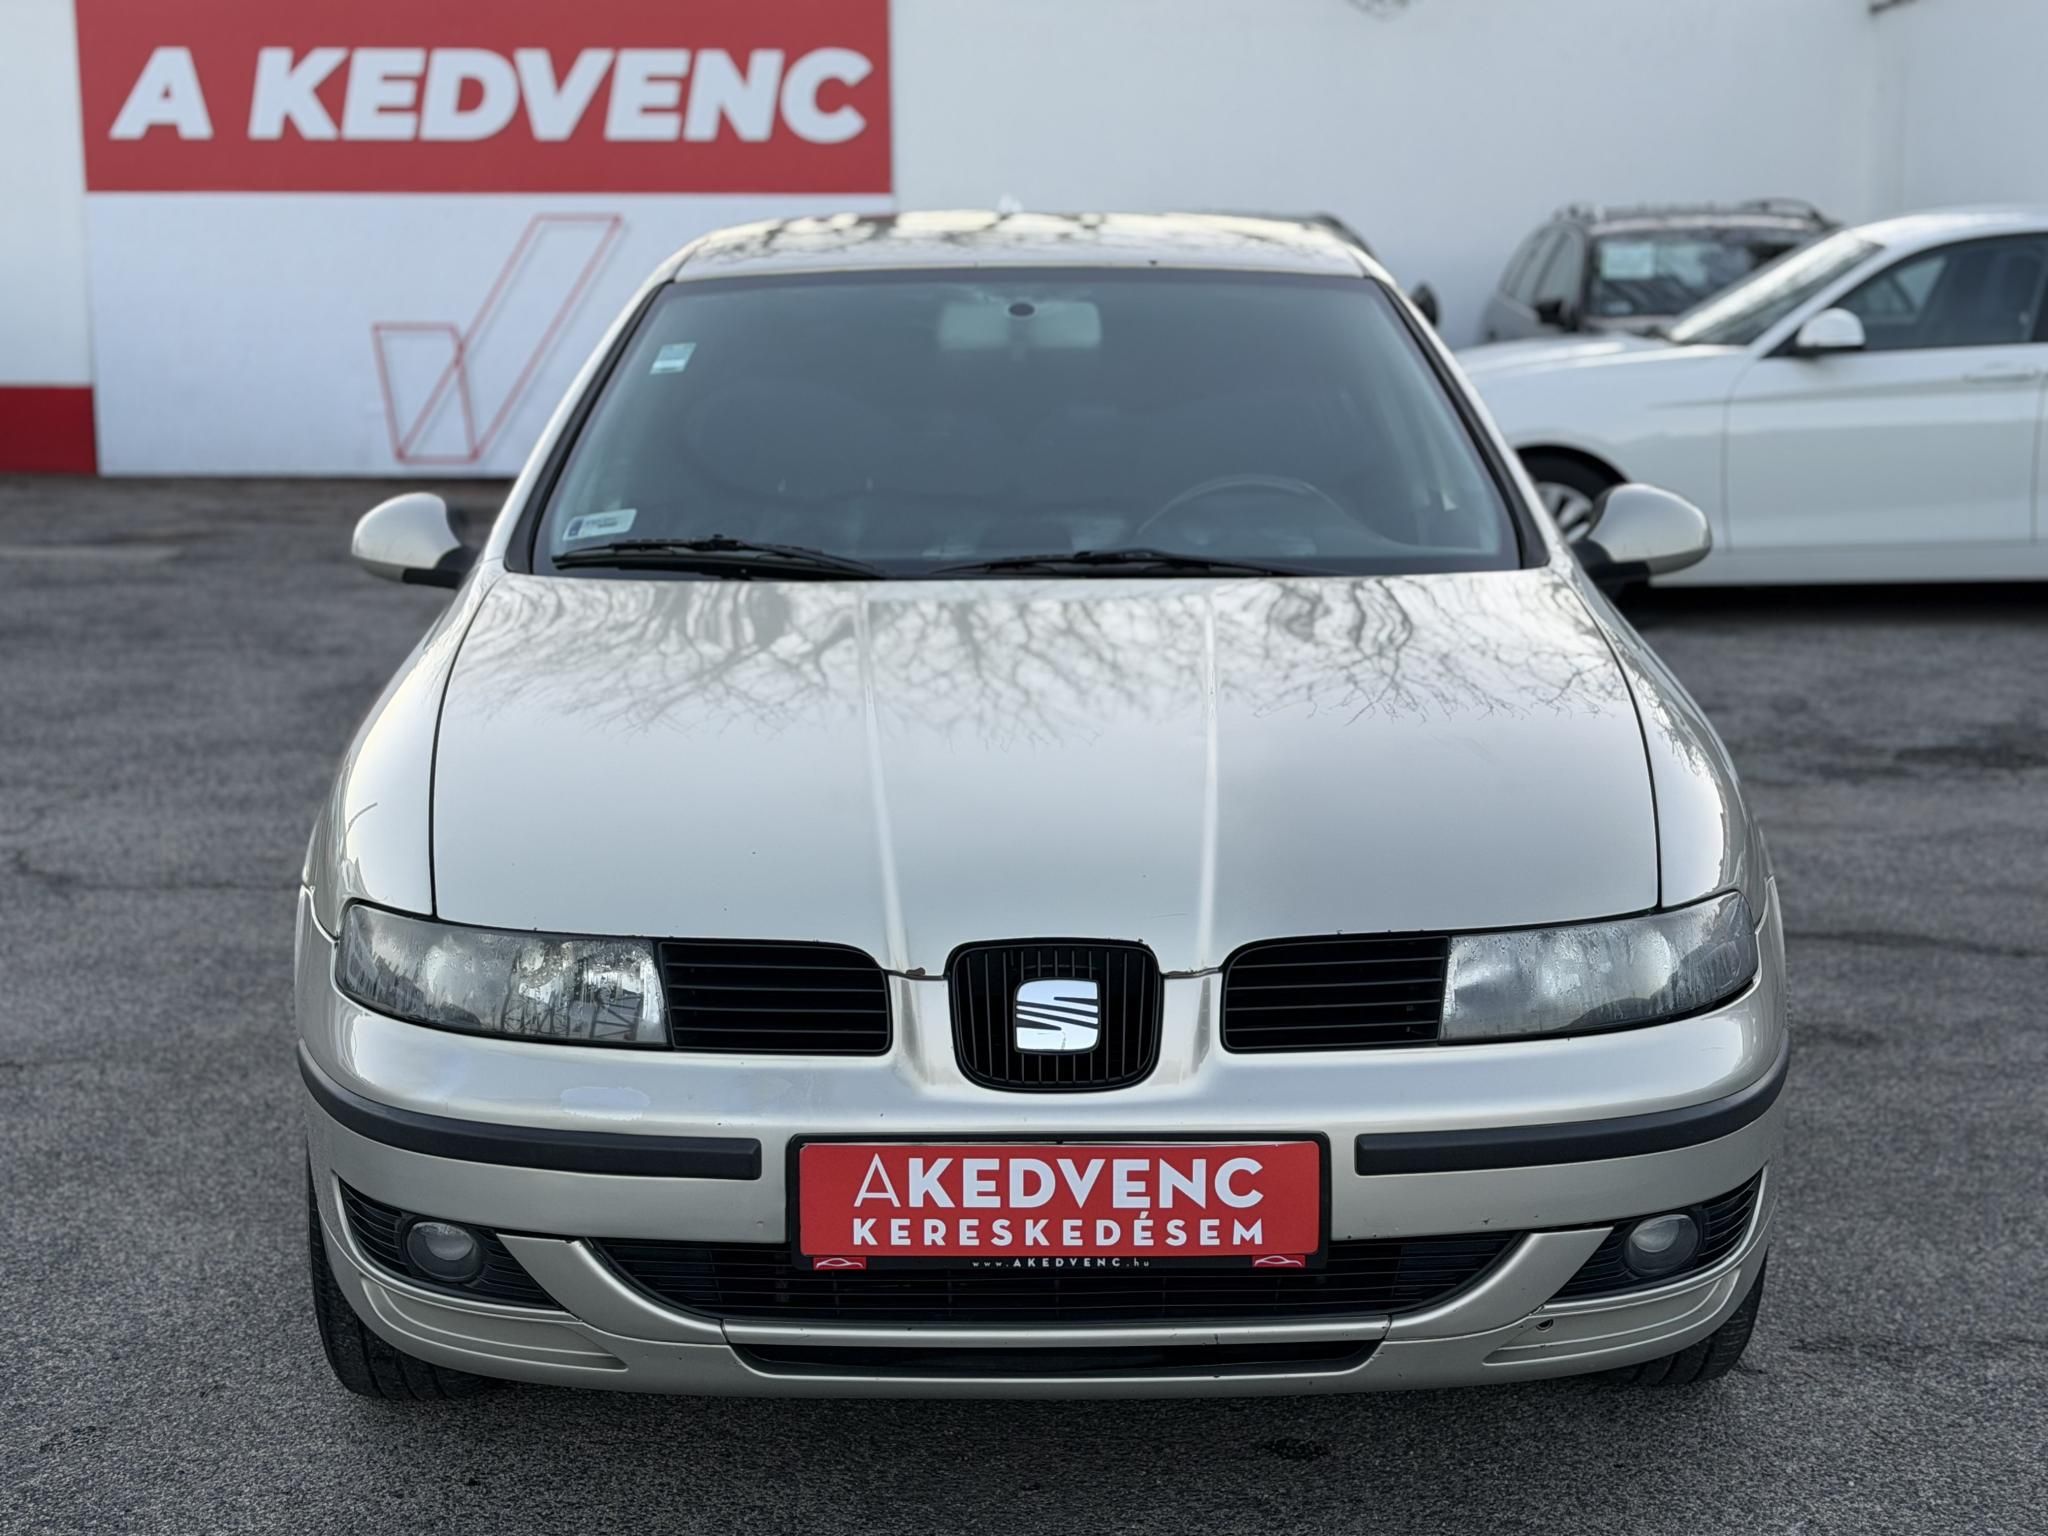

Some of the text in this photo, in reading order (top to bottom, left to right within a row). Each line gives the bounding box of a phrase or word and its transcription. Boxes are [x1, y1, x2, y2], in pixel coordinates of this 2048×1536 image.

[109, 46, 873, 143] A KEDVENC
[853, 1212, 1263, 1247] KERESKEDÉSEM
